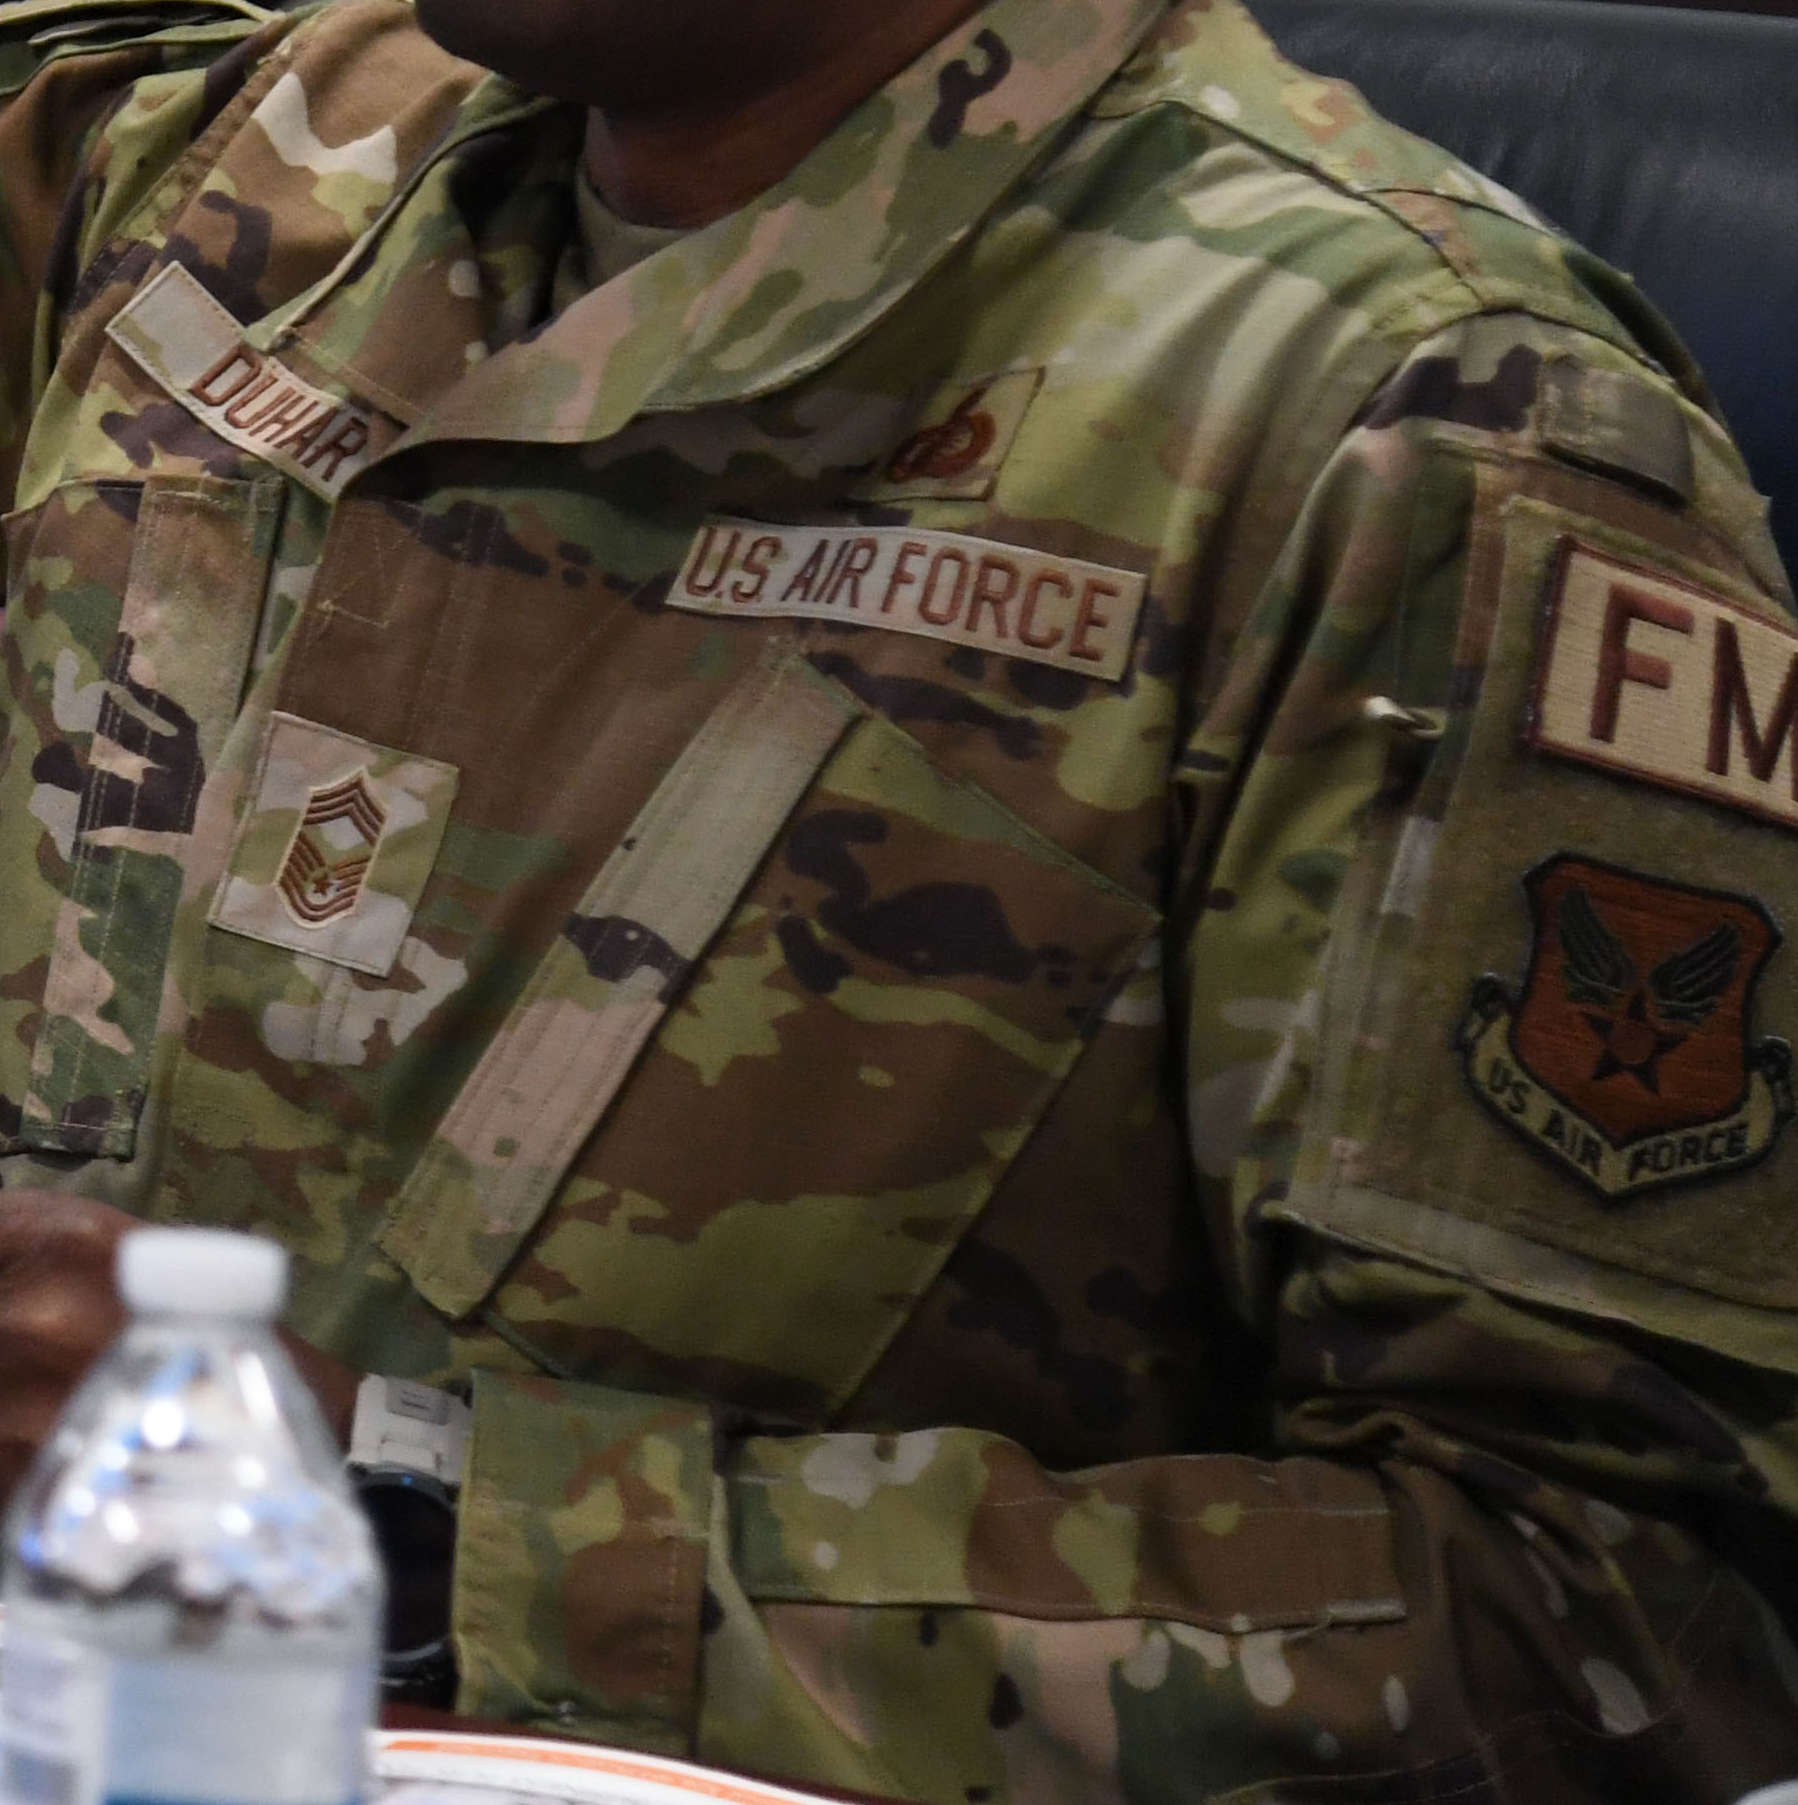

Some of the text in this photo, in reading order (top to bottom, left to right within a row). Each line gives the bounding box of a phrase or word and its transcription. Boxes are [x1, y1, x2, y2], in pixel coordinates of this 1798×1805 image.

[781, 537, 879, 609] AIR
[881, 540, 1122, 662] FORCE
[1590, 584, 1798, 805] FM
[1542, 1108, 1603, 1177] AIR
[1626, 1121, 1751, 1182] FORCE
